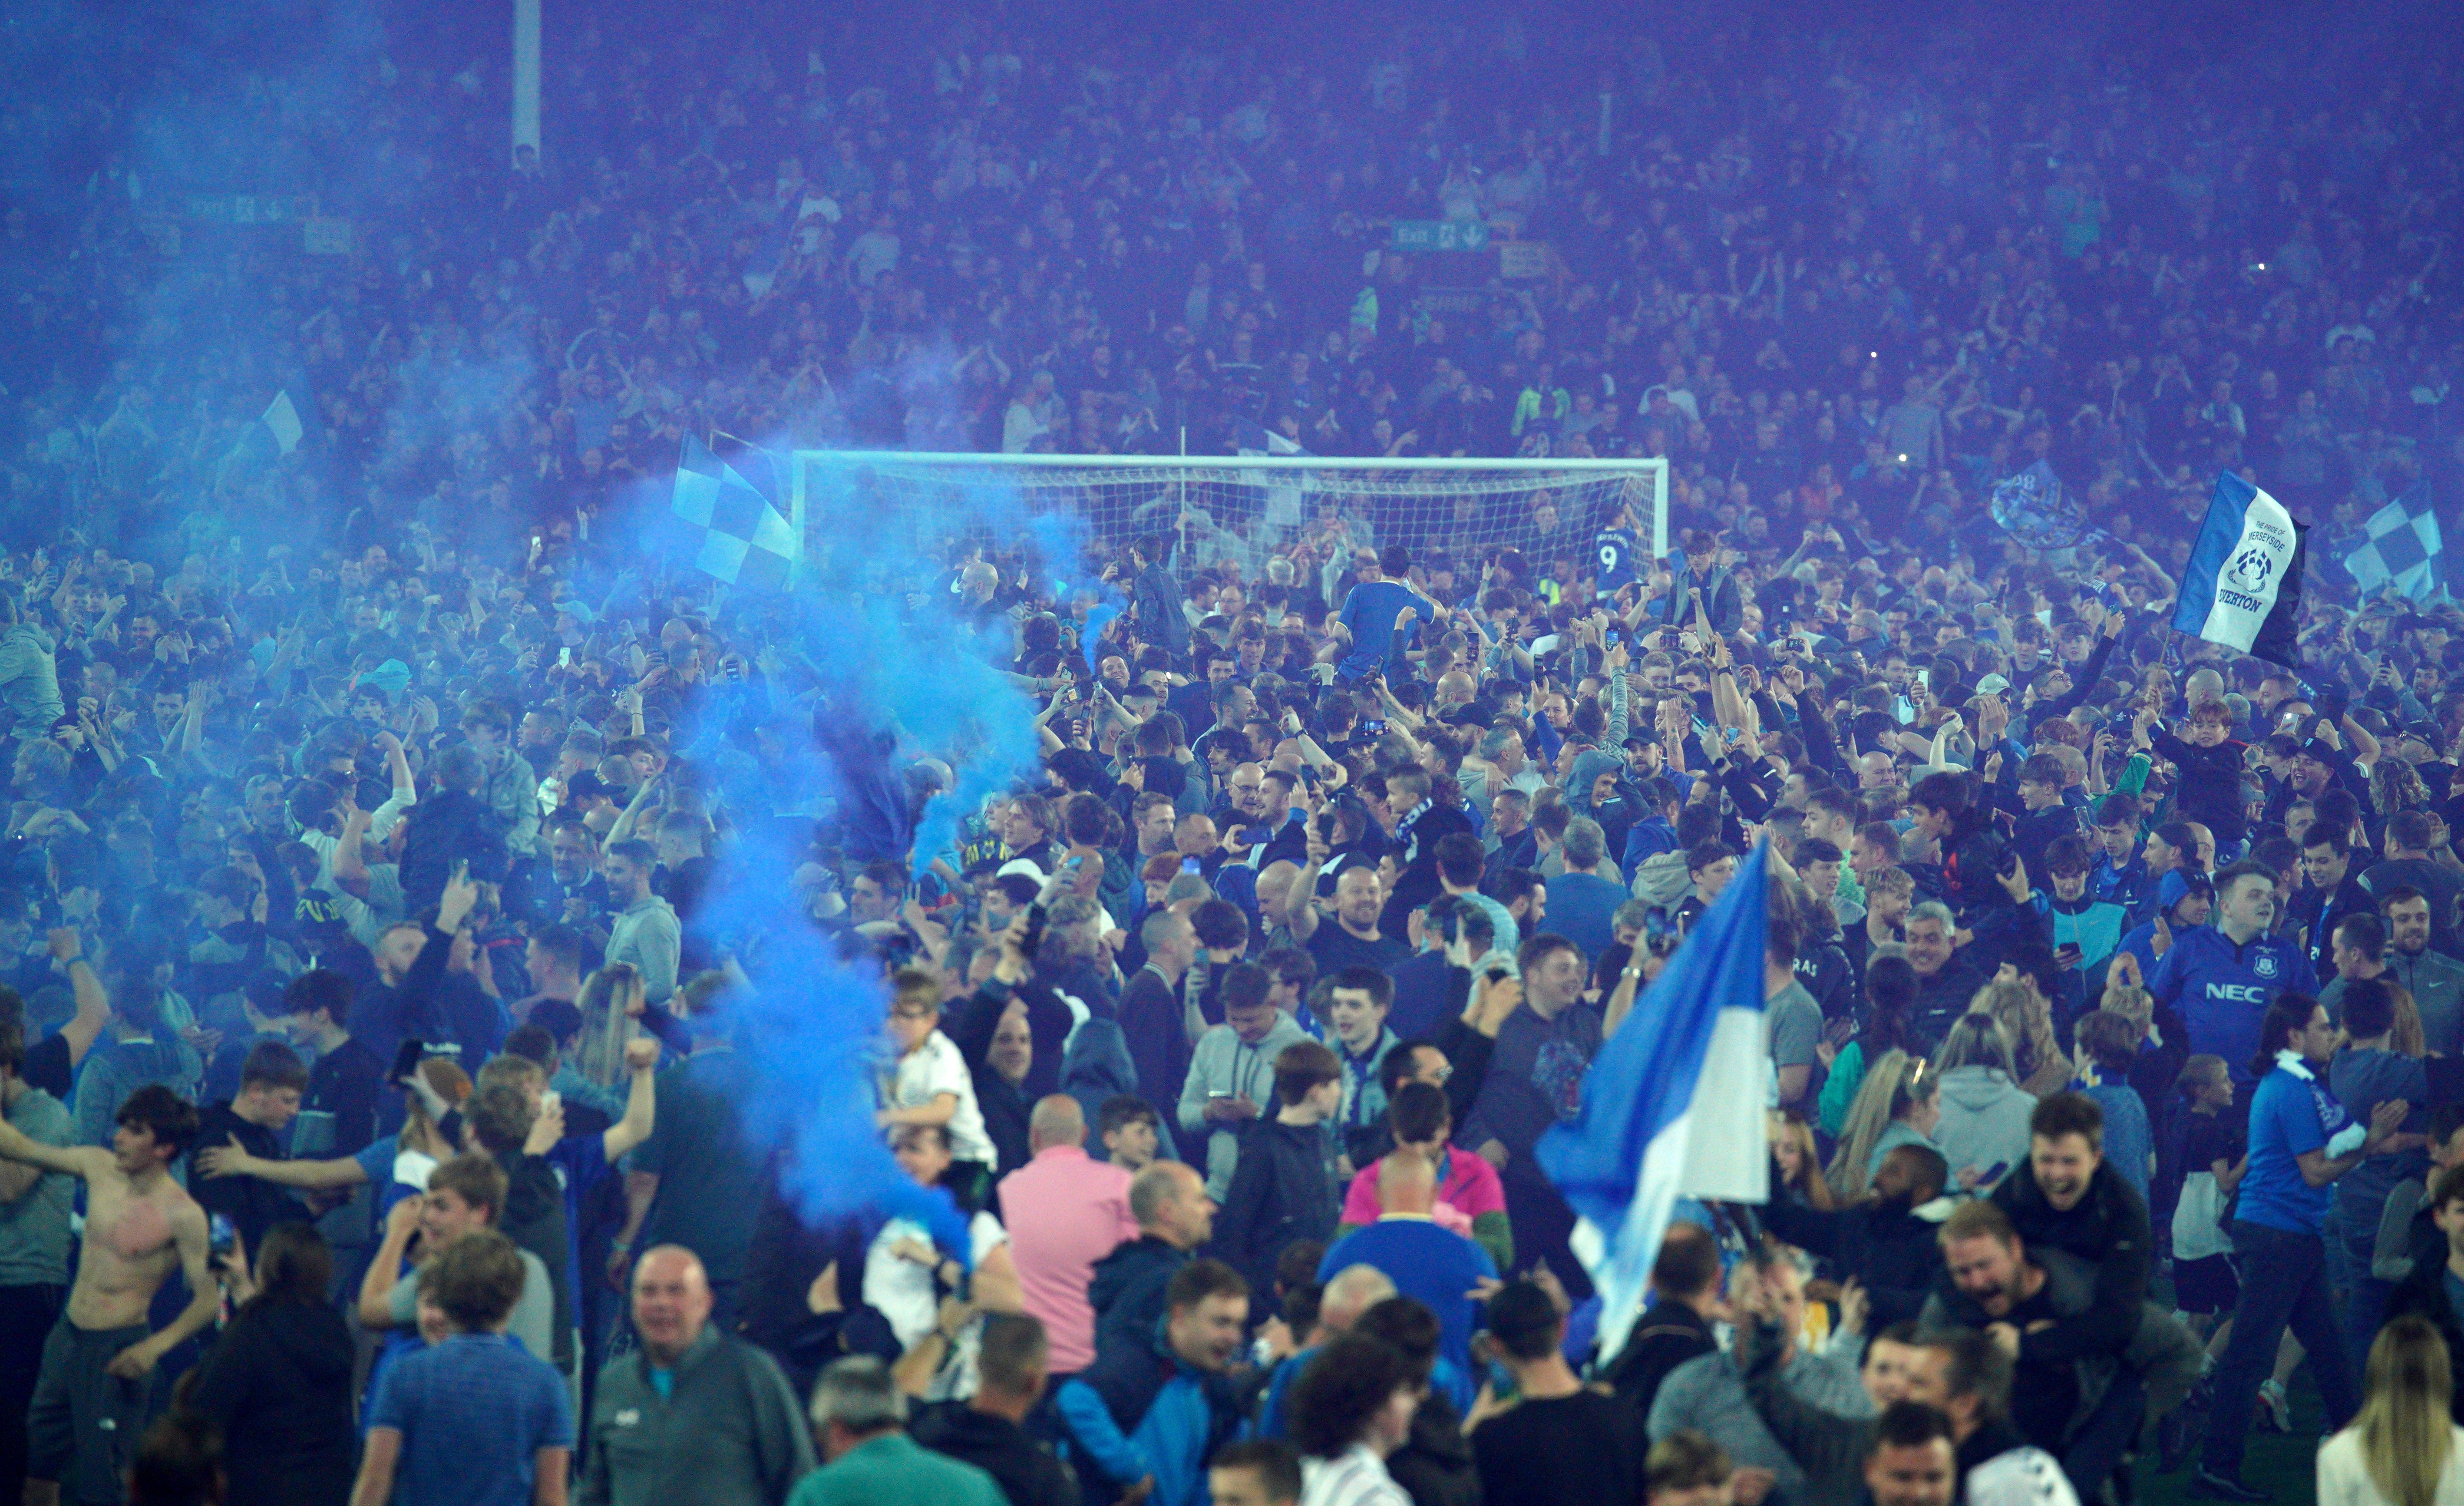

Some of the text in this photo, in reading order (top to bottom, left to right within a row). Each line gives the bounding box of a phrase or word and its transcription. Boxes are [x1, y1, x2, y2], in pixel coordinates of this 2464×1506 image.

[2264, 524, 2279, 534] PRIDE
[2248, 531, 2285, 552] MERSEYSIDE
[1600, 546, 1617, 573] 9
[2206, 983, 2265, 1004] NEC
